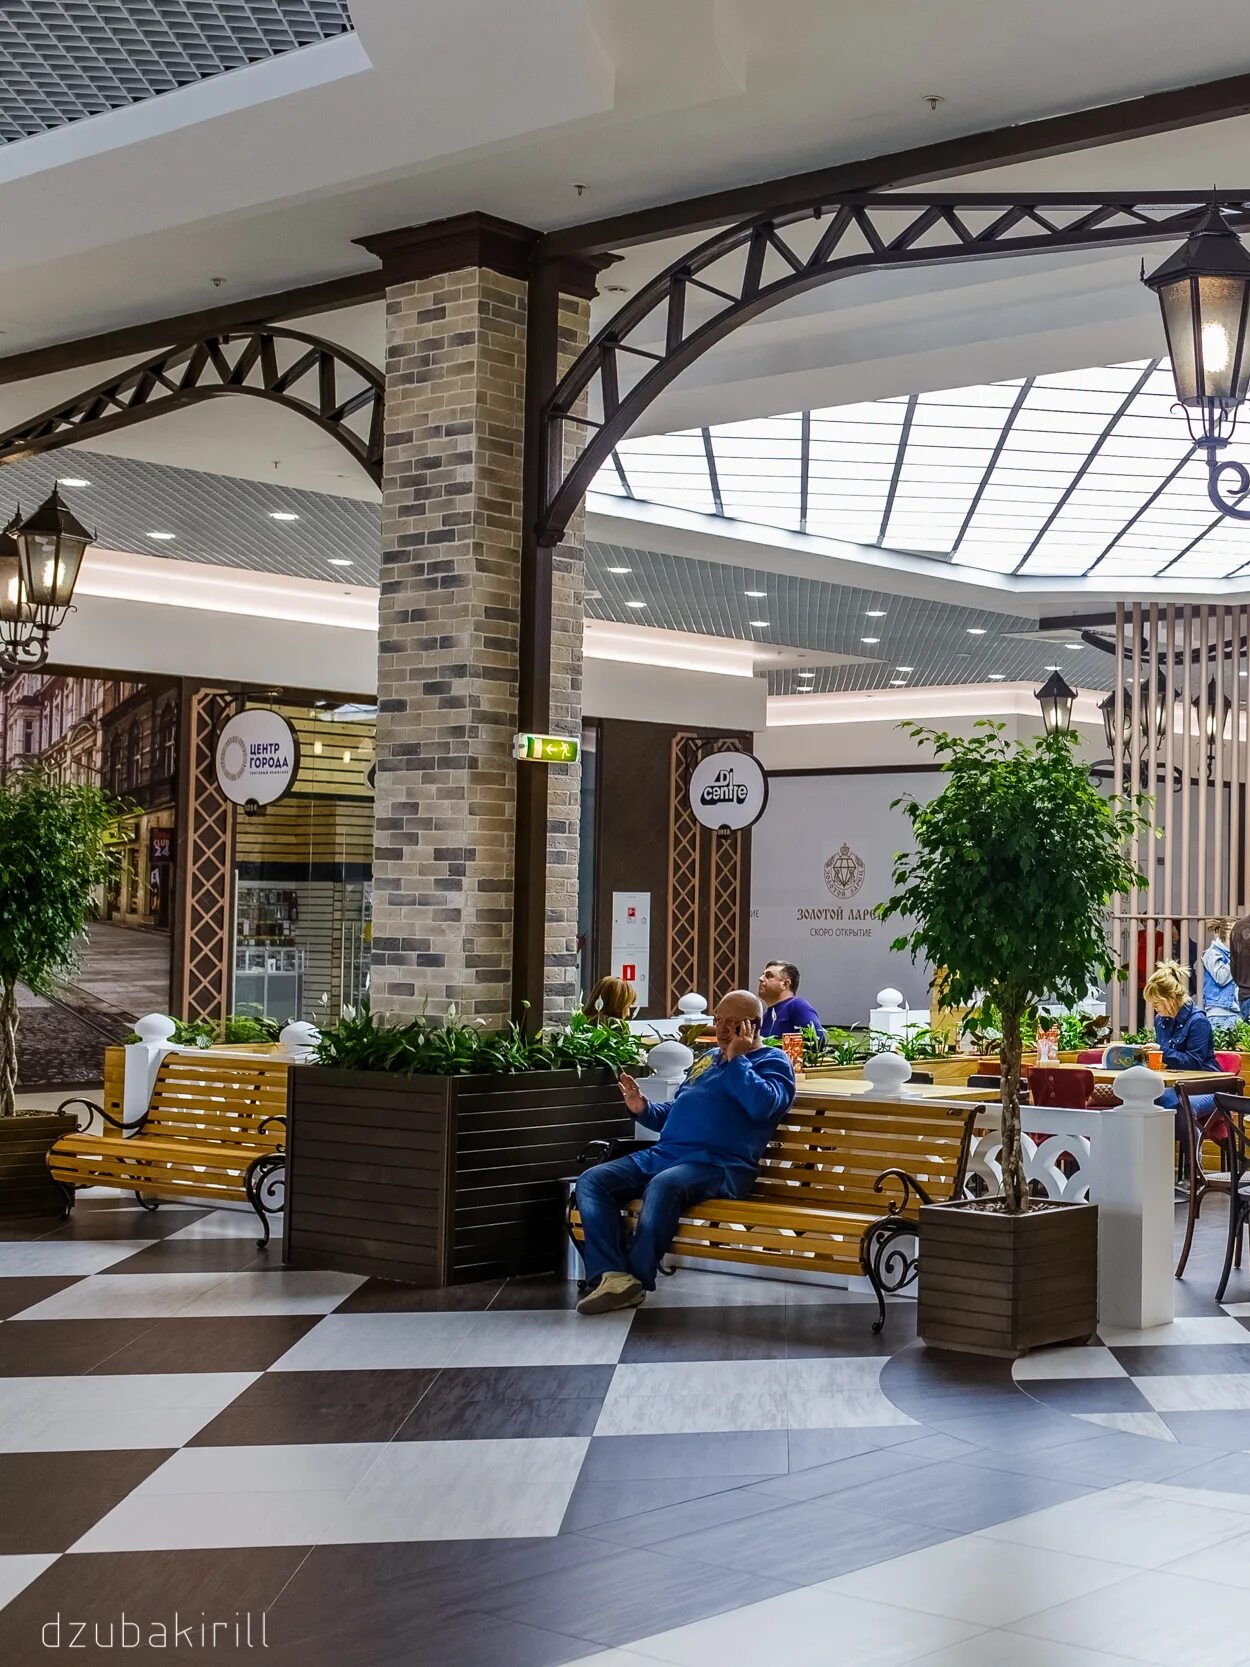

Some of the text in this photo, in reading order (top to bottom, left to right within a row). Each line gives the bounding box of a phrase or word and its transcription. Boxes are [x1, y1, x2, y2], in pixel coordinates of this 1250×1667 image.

[250, 743, 280, 756] ЦЕНТР
[249, 756, 289, 769] ГОРОДА
[797, 906, 844, 921] ЗОЛОТОЙ
[809, 928, 872, 937] СКОРО ОТКРЫТИЕ
